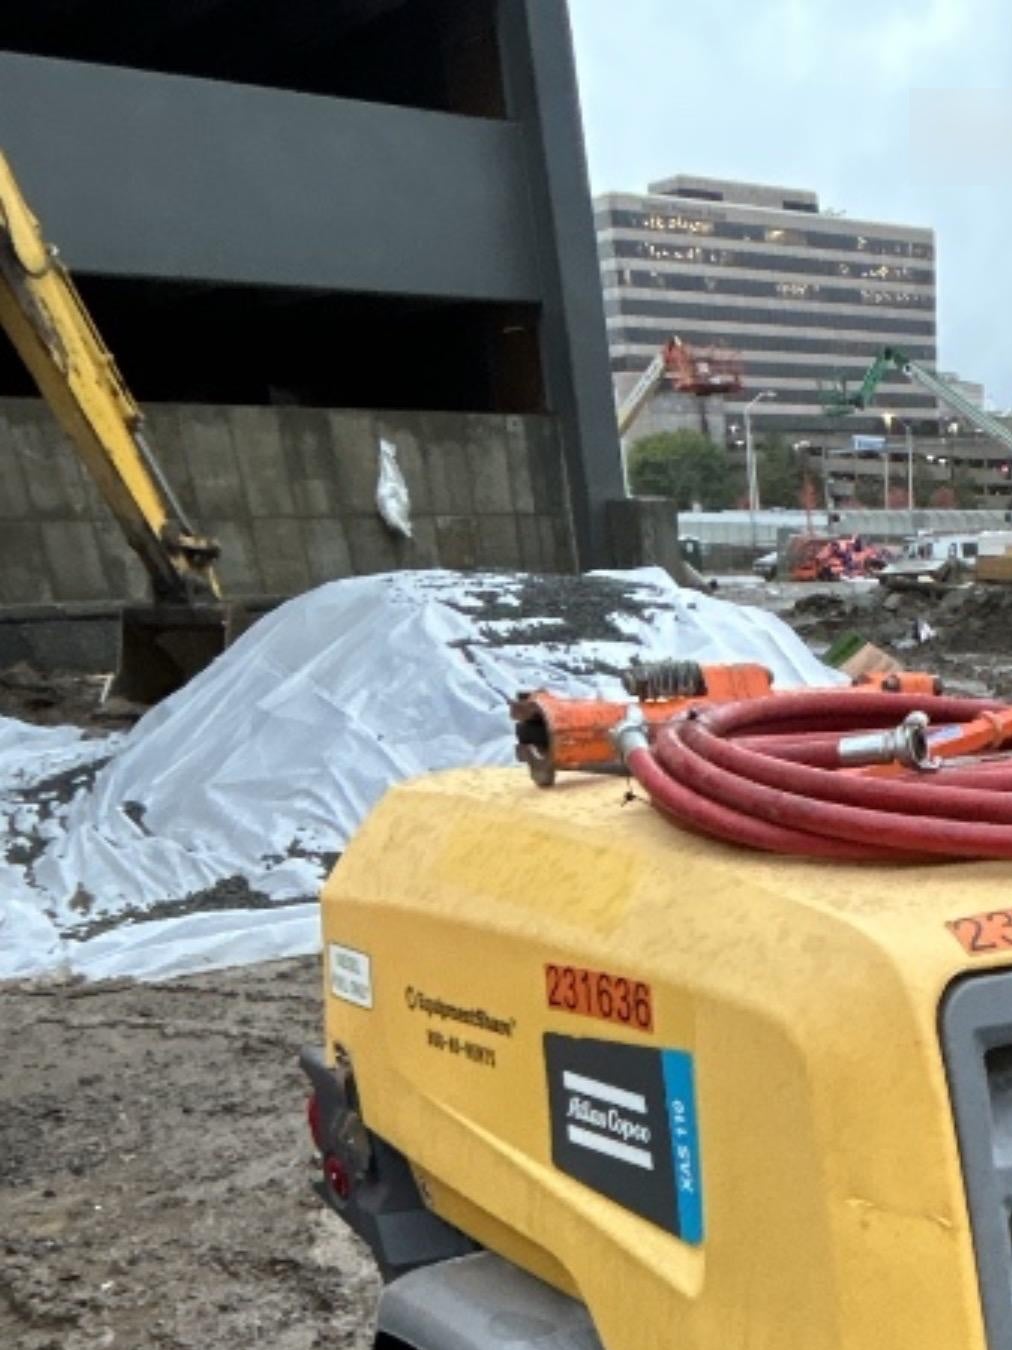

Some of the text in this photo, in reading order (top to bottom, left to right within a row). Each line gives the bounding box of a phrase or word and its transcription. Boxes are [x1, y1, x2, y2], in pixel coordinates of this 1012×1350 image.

[546, 964, 650, 1028] 231636
[566, 1096, 651, 1144] Atlas Copco
[676, 1144, 694, 1195] XAS
